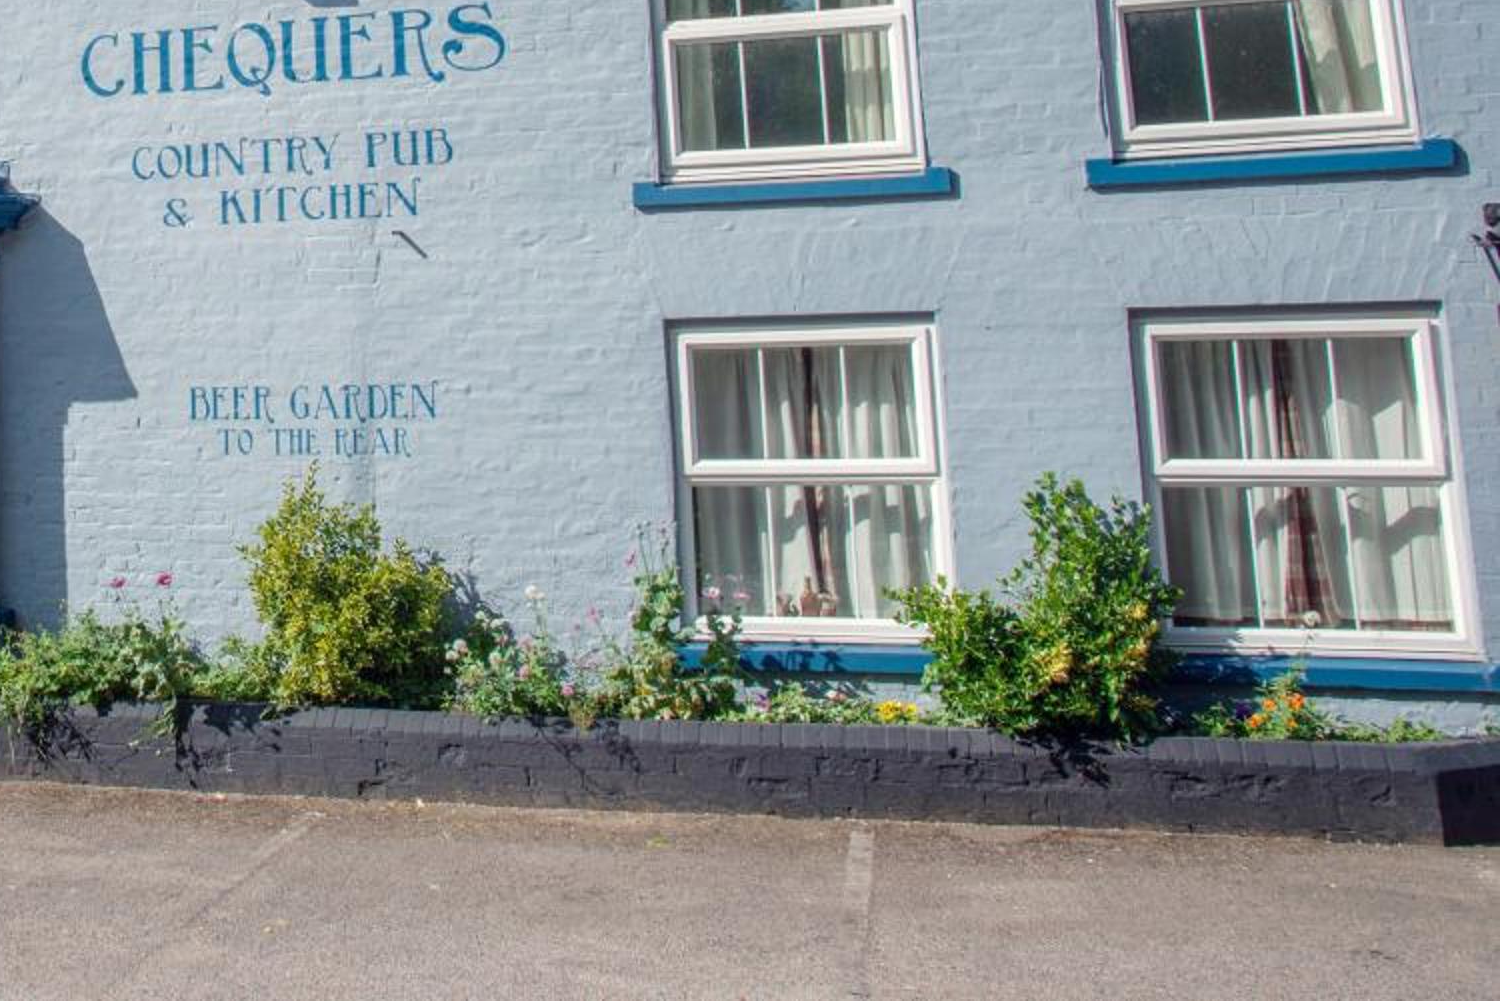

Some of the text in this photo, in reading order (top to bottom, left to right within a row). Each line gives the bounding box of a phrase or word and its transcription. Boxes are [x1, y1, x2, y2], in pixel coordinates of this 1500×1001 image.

[81, 2, 506, 96] CHEQUERS
[132, 128, 454, 180] COUNTRY PUB
[162, 178, 420, 228] & KITCHEN
[189, 380, 439, 423] BEER GARDEN
[218, 428, 412, 458] TO THE REAR
